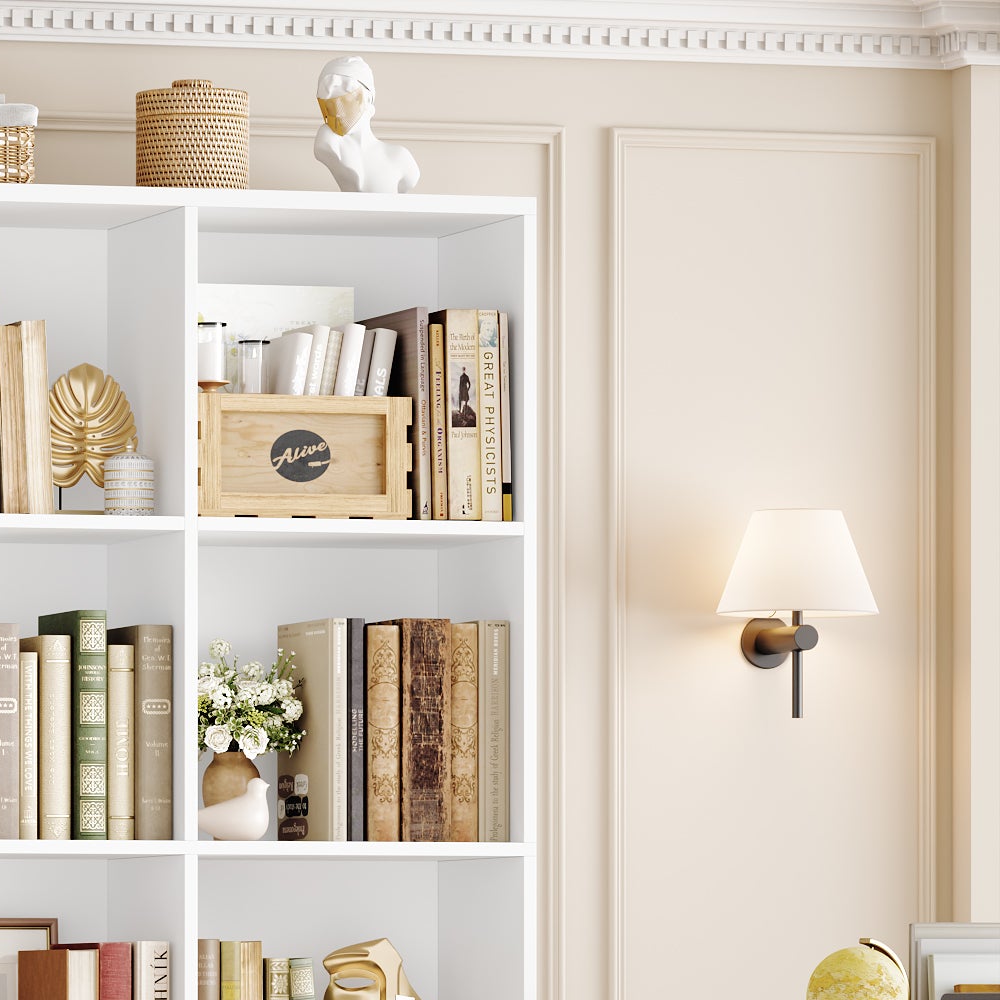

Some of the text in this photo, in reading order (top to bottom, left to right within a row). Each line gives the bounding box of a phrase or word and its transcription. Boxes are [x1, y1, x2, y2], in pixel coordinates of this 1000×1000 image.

[418, 319, 426, 353] Suspended
[373, 367, 387, 395] ALS
[483, 351, 496, 495] GREAT PHYSICISTS
[272, 441, 328, 470] Alive
[24, 665, 32, 792] WITH THE THINGS WE LOVE
[116, 719, 129, 777] HOME
